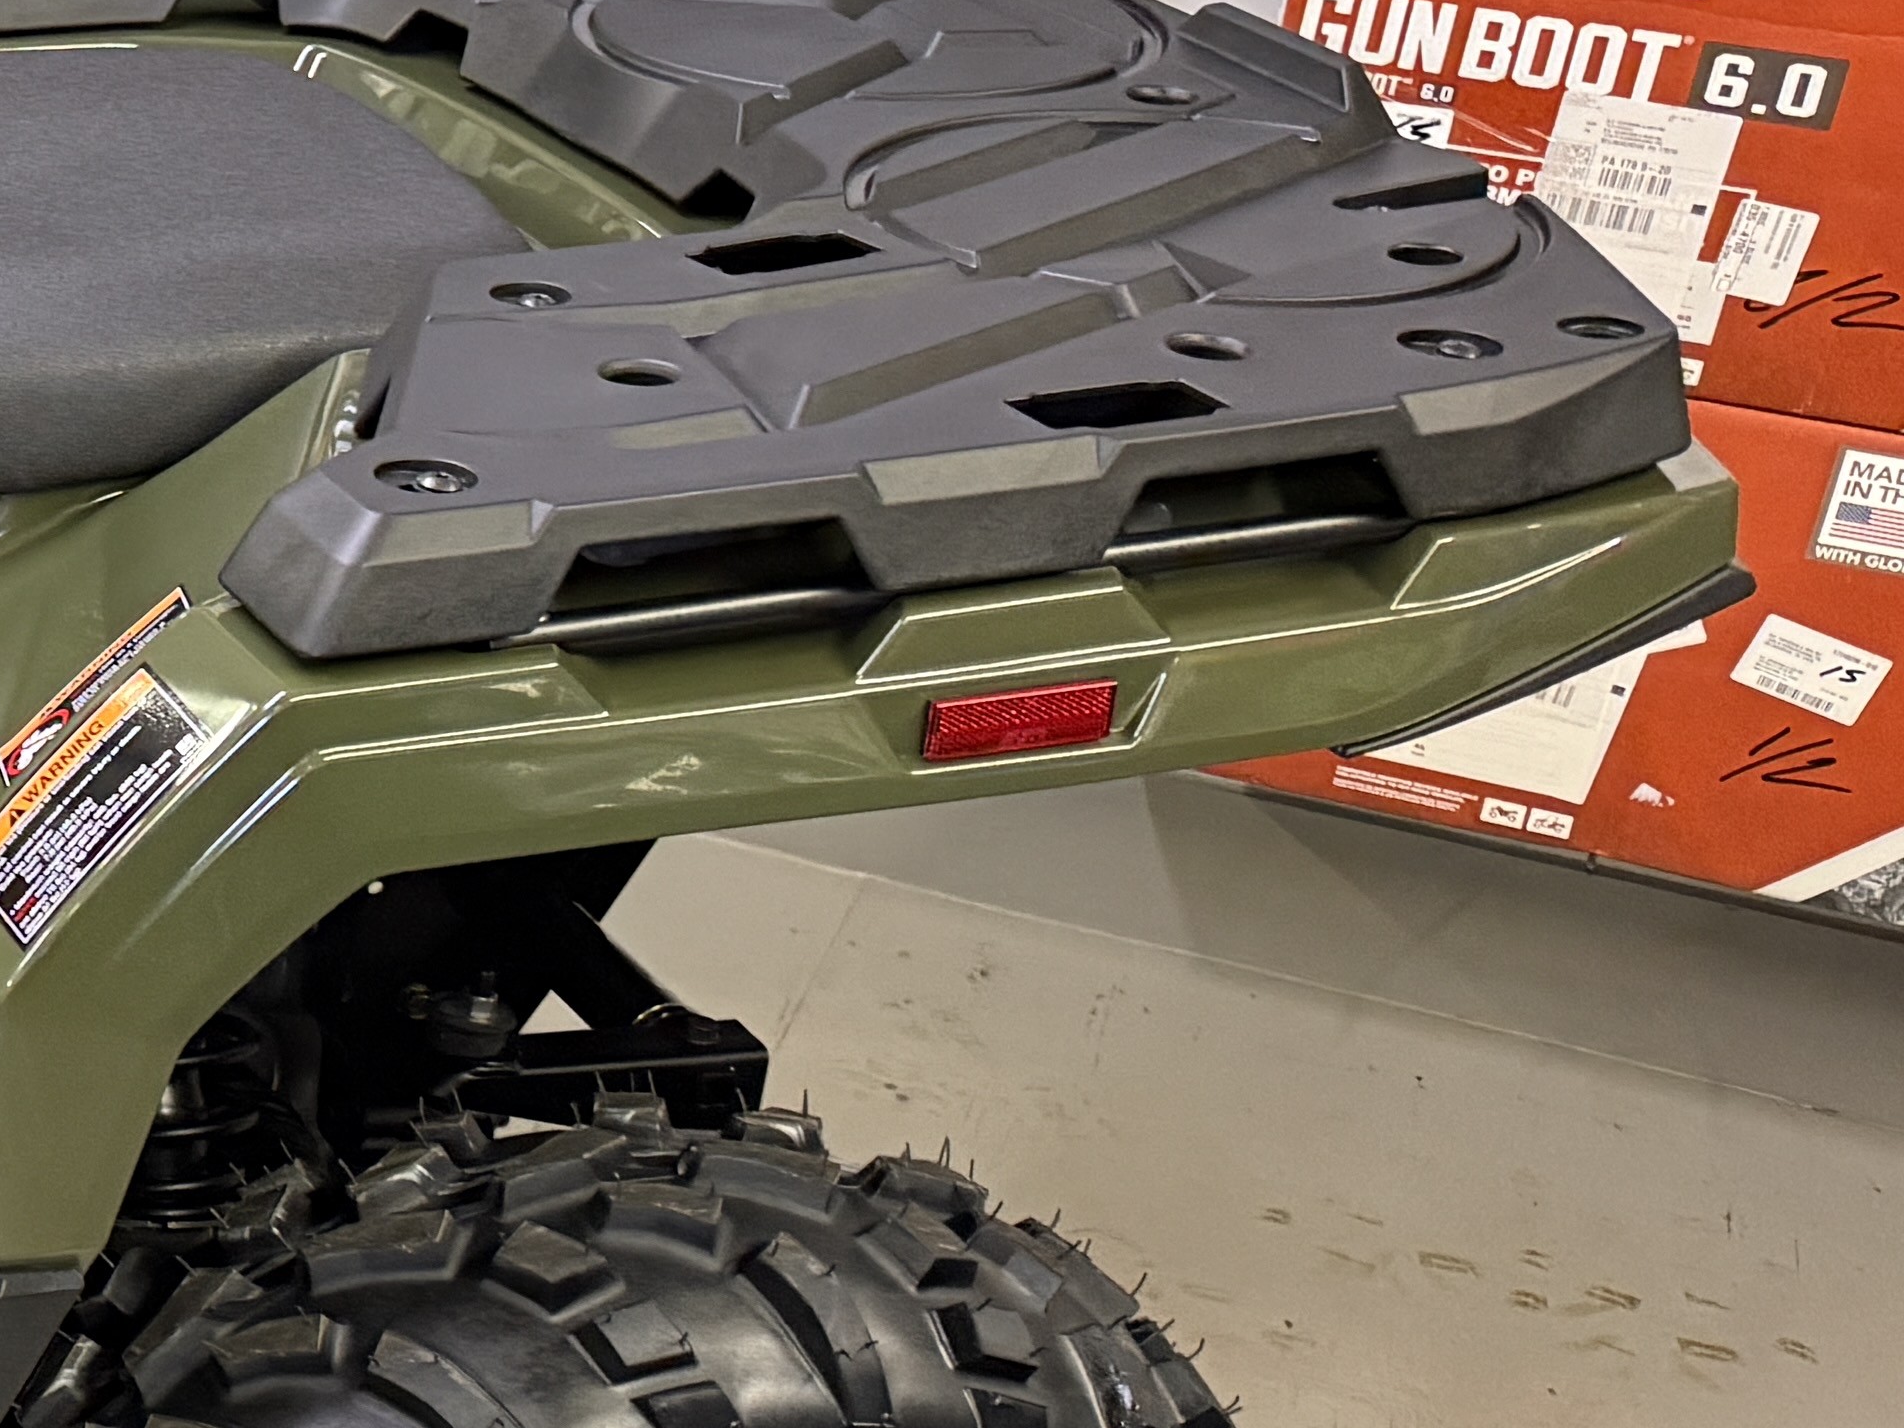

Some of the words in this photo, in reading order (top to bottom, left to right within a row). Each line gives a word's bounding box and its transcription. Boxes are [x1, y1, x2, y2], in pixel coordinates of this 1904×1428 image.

[1457, 5, 1684, 105] BOOT
[1703, 52, 1829, 120] 6.0
[1418, 82, 1456, 105] 6.0
[1842, 479, 1874, 501] IN
[1814, 544, 1861, 566] WITH
[20, 718, 106, 804] WARNING
